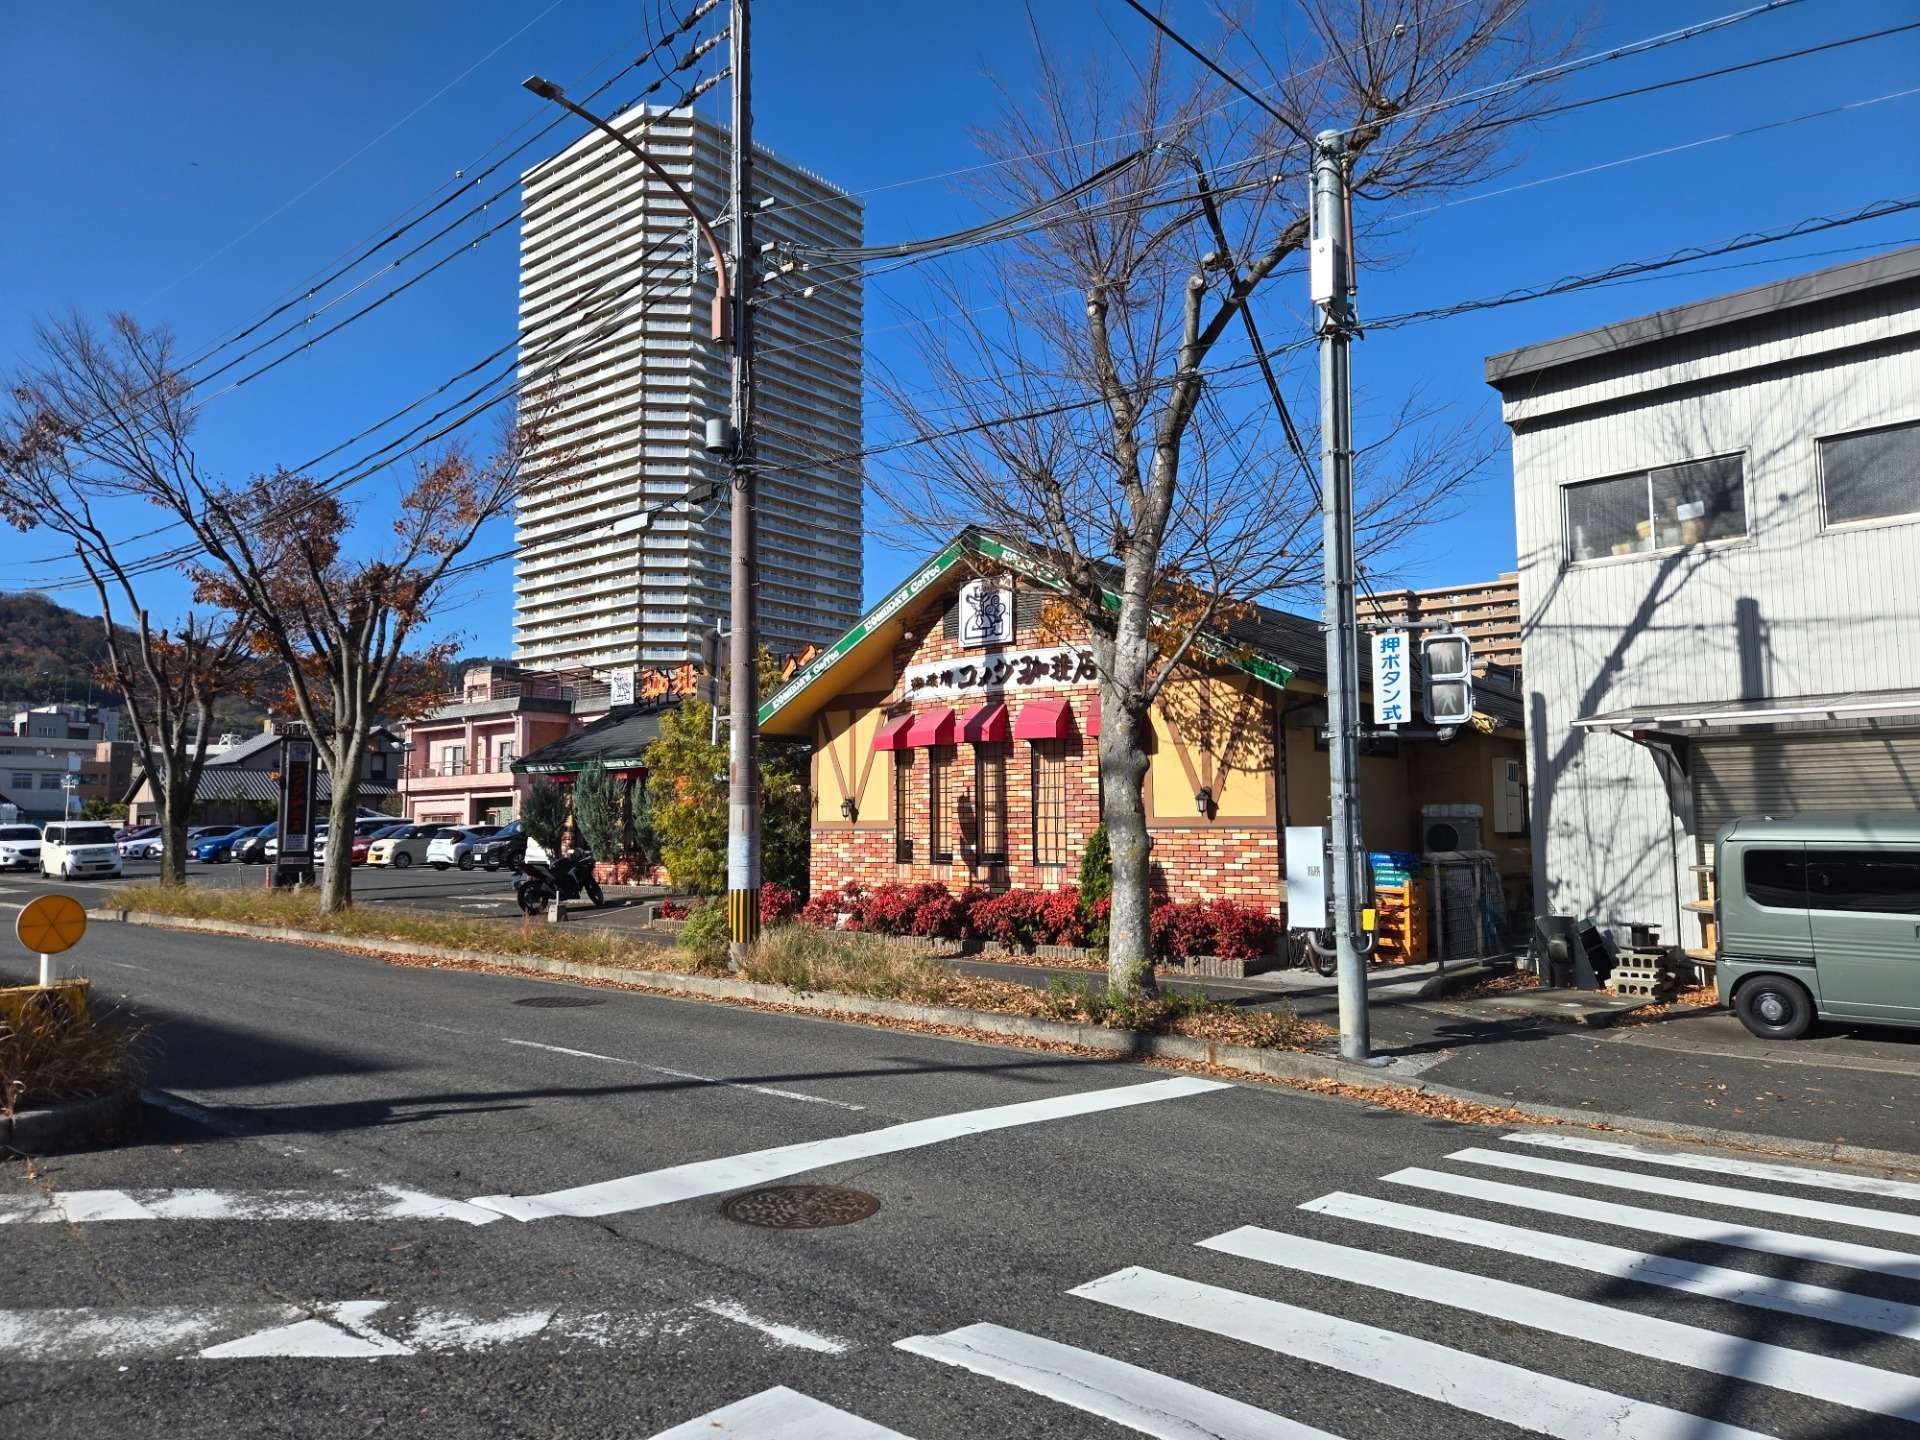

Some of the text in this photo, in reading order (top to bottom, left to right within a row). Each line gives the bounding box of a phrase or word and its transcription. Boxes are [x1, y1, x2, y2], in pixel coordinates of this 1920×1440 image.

[910, 565, 940, 593] Coffee
[958, 650, 1098, 690] コメダ珈琲店
[1380, 637, 1402, 721] 押ボタン式
